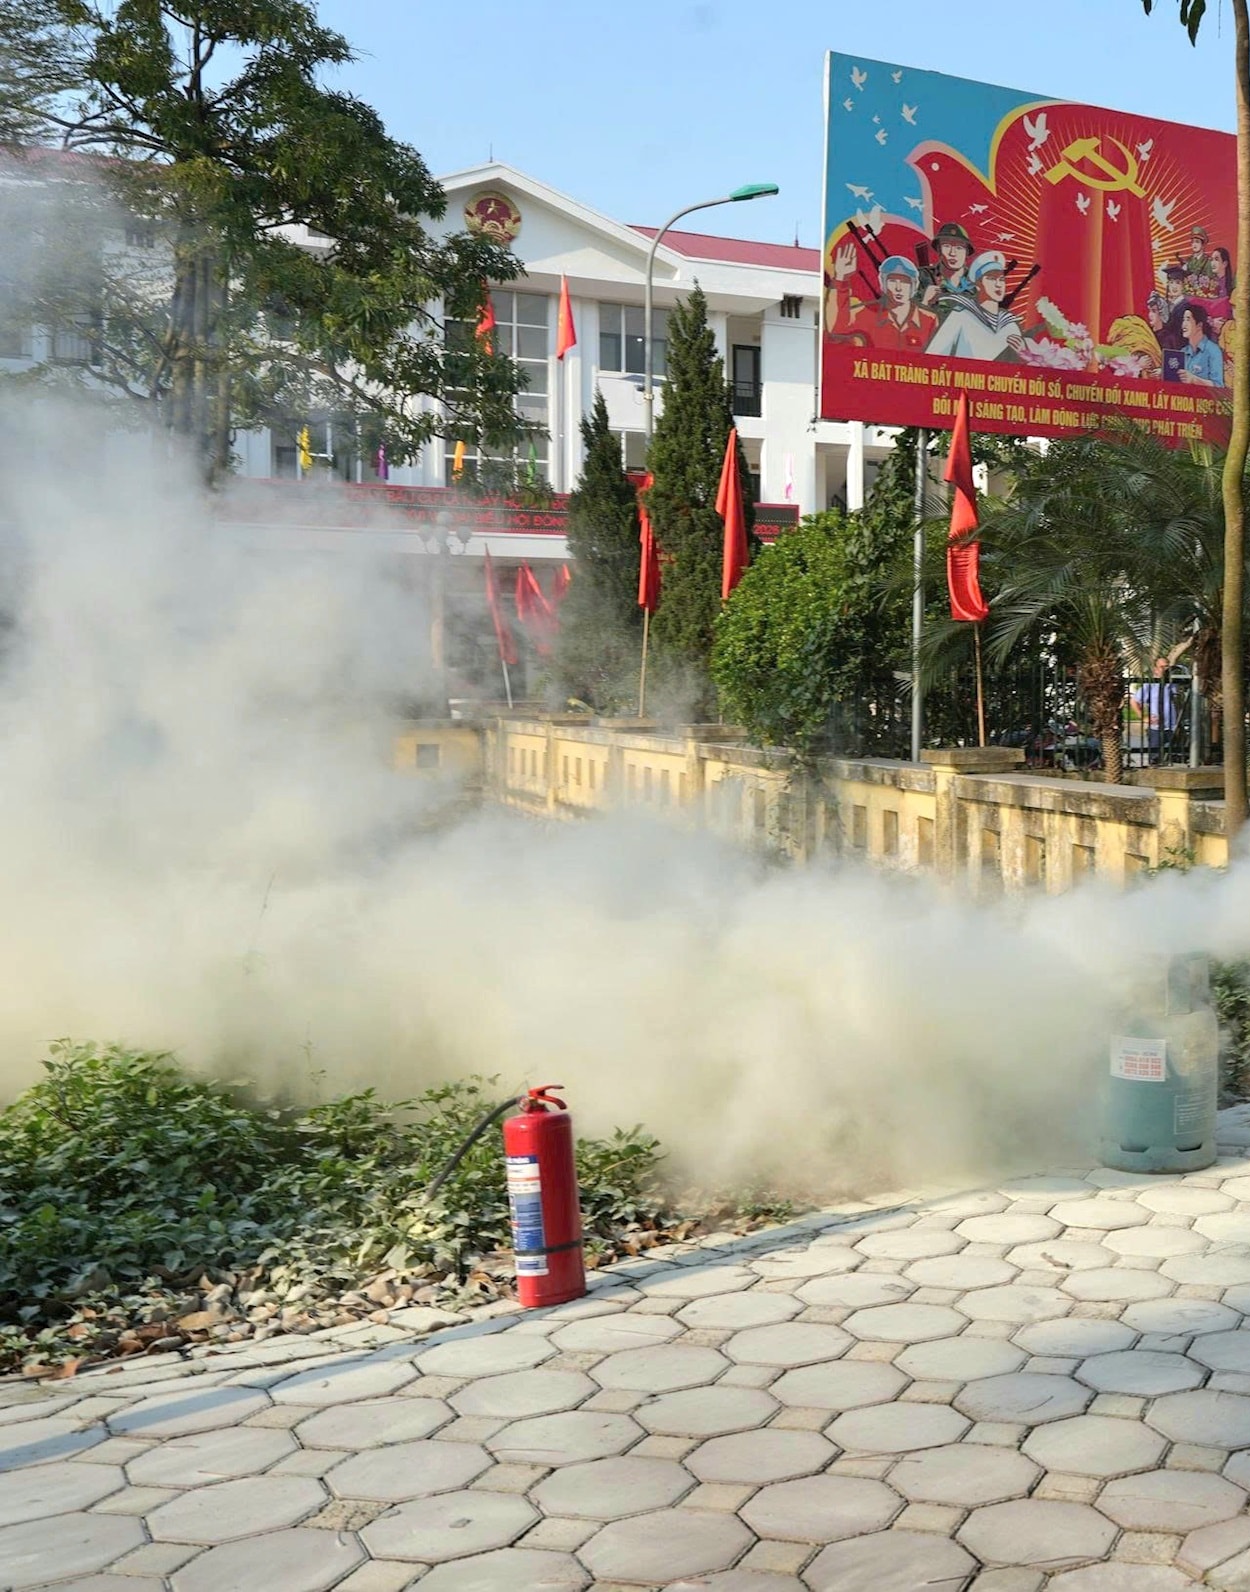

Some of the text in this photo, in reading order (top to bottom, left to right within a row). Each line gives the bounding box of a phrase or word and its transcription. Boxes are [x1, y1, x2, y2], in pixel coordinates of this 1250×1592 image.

[853, 358, 869, 379] XÃ
[871, 360, 892, 381] BÁT
[894, 363, 929, 385] TRÀNG
[931, 363, 952, 387] ĐẨY
[988, 371, 1027, 395] CHUYỂN
[1028, 374, 1045, 397] ĐỔI
[1048, 377, 1064, 400] SỐ,
[1066, 380, 1104, 402] CHUYỂN
[1105, 383, 1121, 405] ĐỔI
[1123, 389, 1150, 409] XANH,
[1153, 388, 1169, 410] LẤY
[1171, 395, 1194, 413] KHOA
[933, 392, 951, 414] ĐỔI
[976, 399, 1003, 421] SÁNG
[1006, 404, 1028, 425] TẠO,
[1030, 404, 1050, 425] LÀM
[1052, 407, 1079, 430] ĐỘNG
[1176, 418, 1203, 440] TRIỂN
